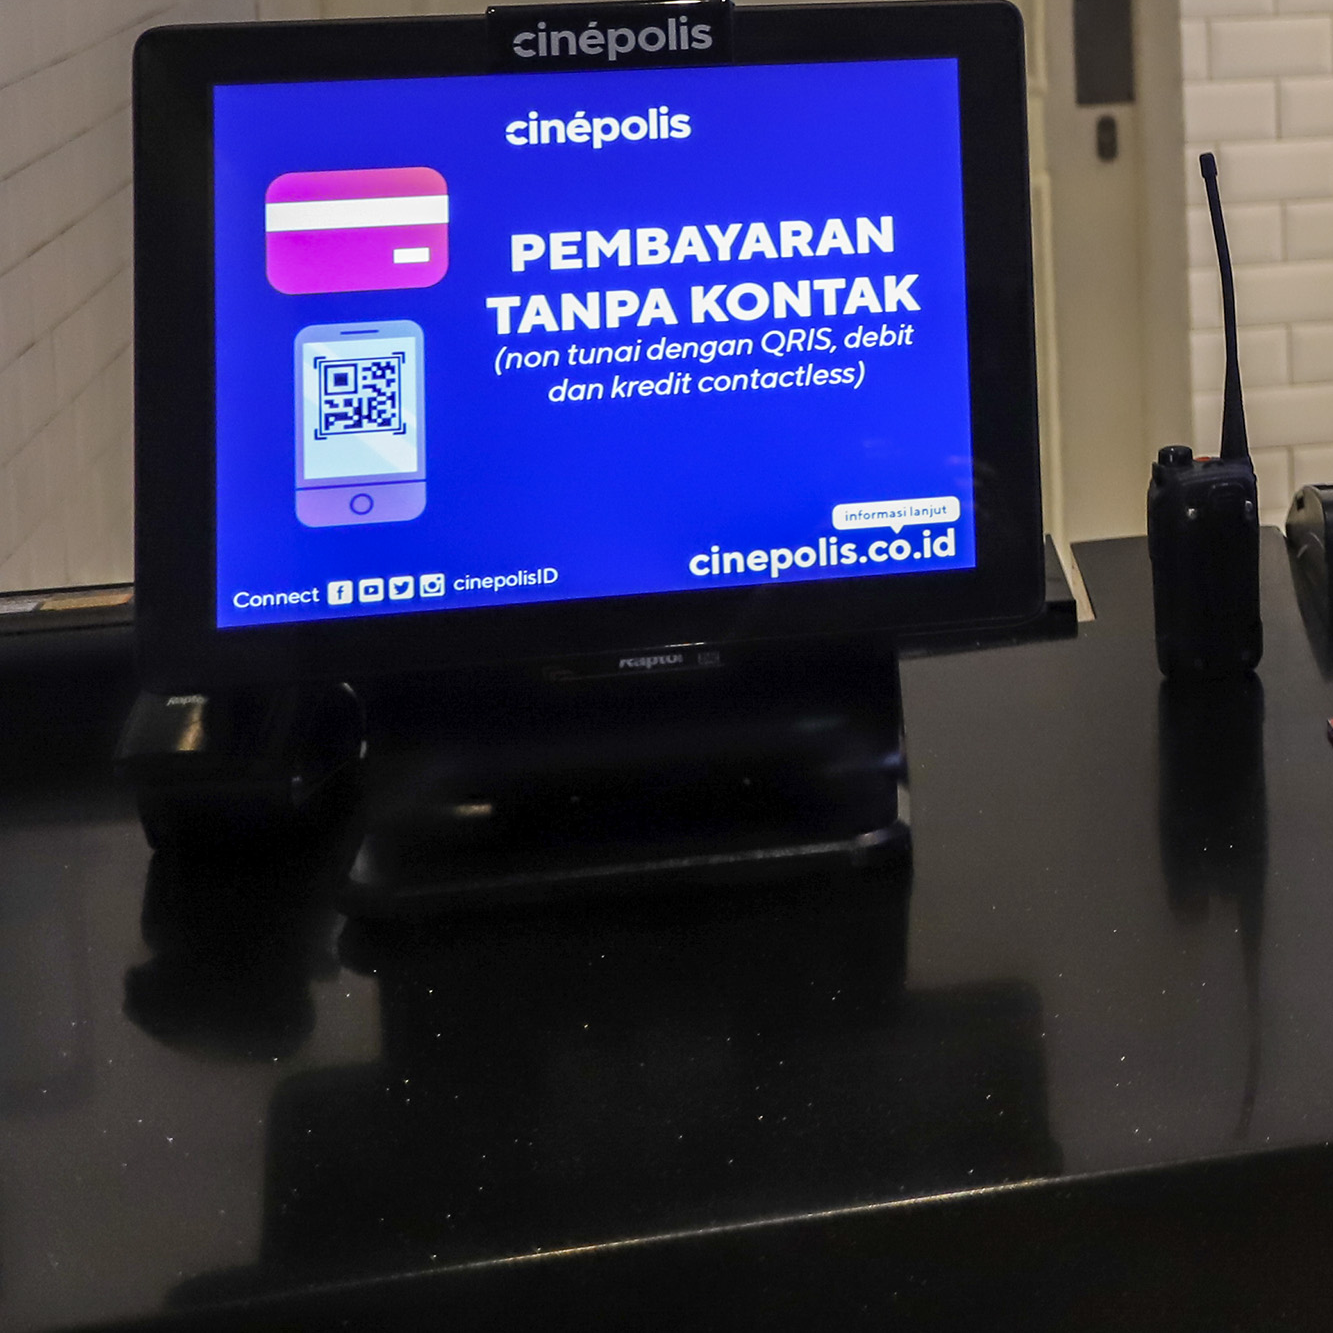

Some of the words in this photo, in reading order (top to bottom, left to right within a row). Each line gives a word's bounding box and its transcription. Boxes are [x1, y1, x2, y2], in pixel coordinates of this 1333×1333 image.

[513, 16, 713, 61] cinépolis
[505, 105, 692, 149] cinépolis
[510, 215, 895, 273] PEMBAYARAN
[486, 288, 679, 335] TANPA
[691, 274, 921, 324] KONTAK
[493, 346, 560, 376] (non
[567, 339, 643, 366] tunai
[646, 335, 754, 364] dengan
[760, 327, 837, 354] QRIS,
[844, 323, 916, 349] debit
[548, 378, 604, 402] dan
[610, 371, 691, 400] kredit
[697, 360, 866, 394] contactless)
[845, 506, 907, 522] informasi
[910, 504, 947, 518] lanjut
[688, 527, 956, 578] cinepolis.co.id
[233, 587, 320, 609] Connect
[453, 567, 559, 592] cinepolisID
